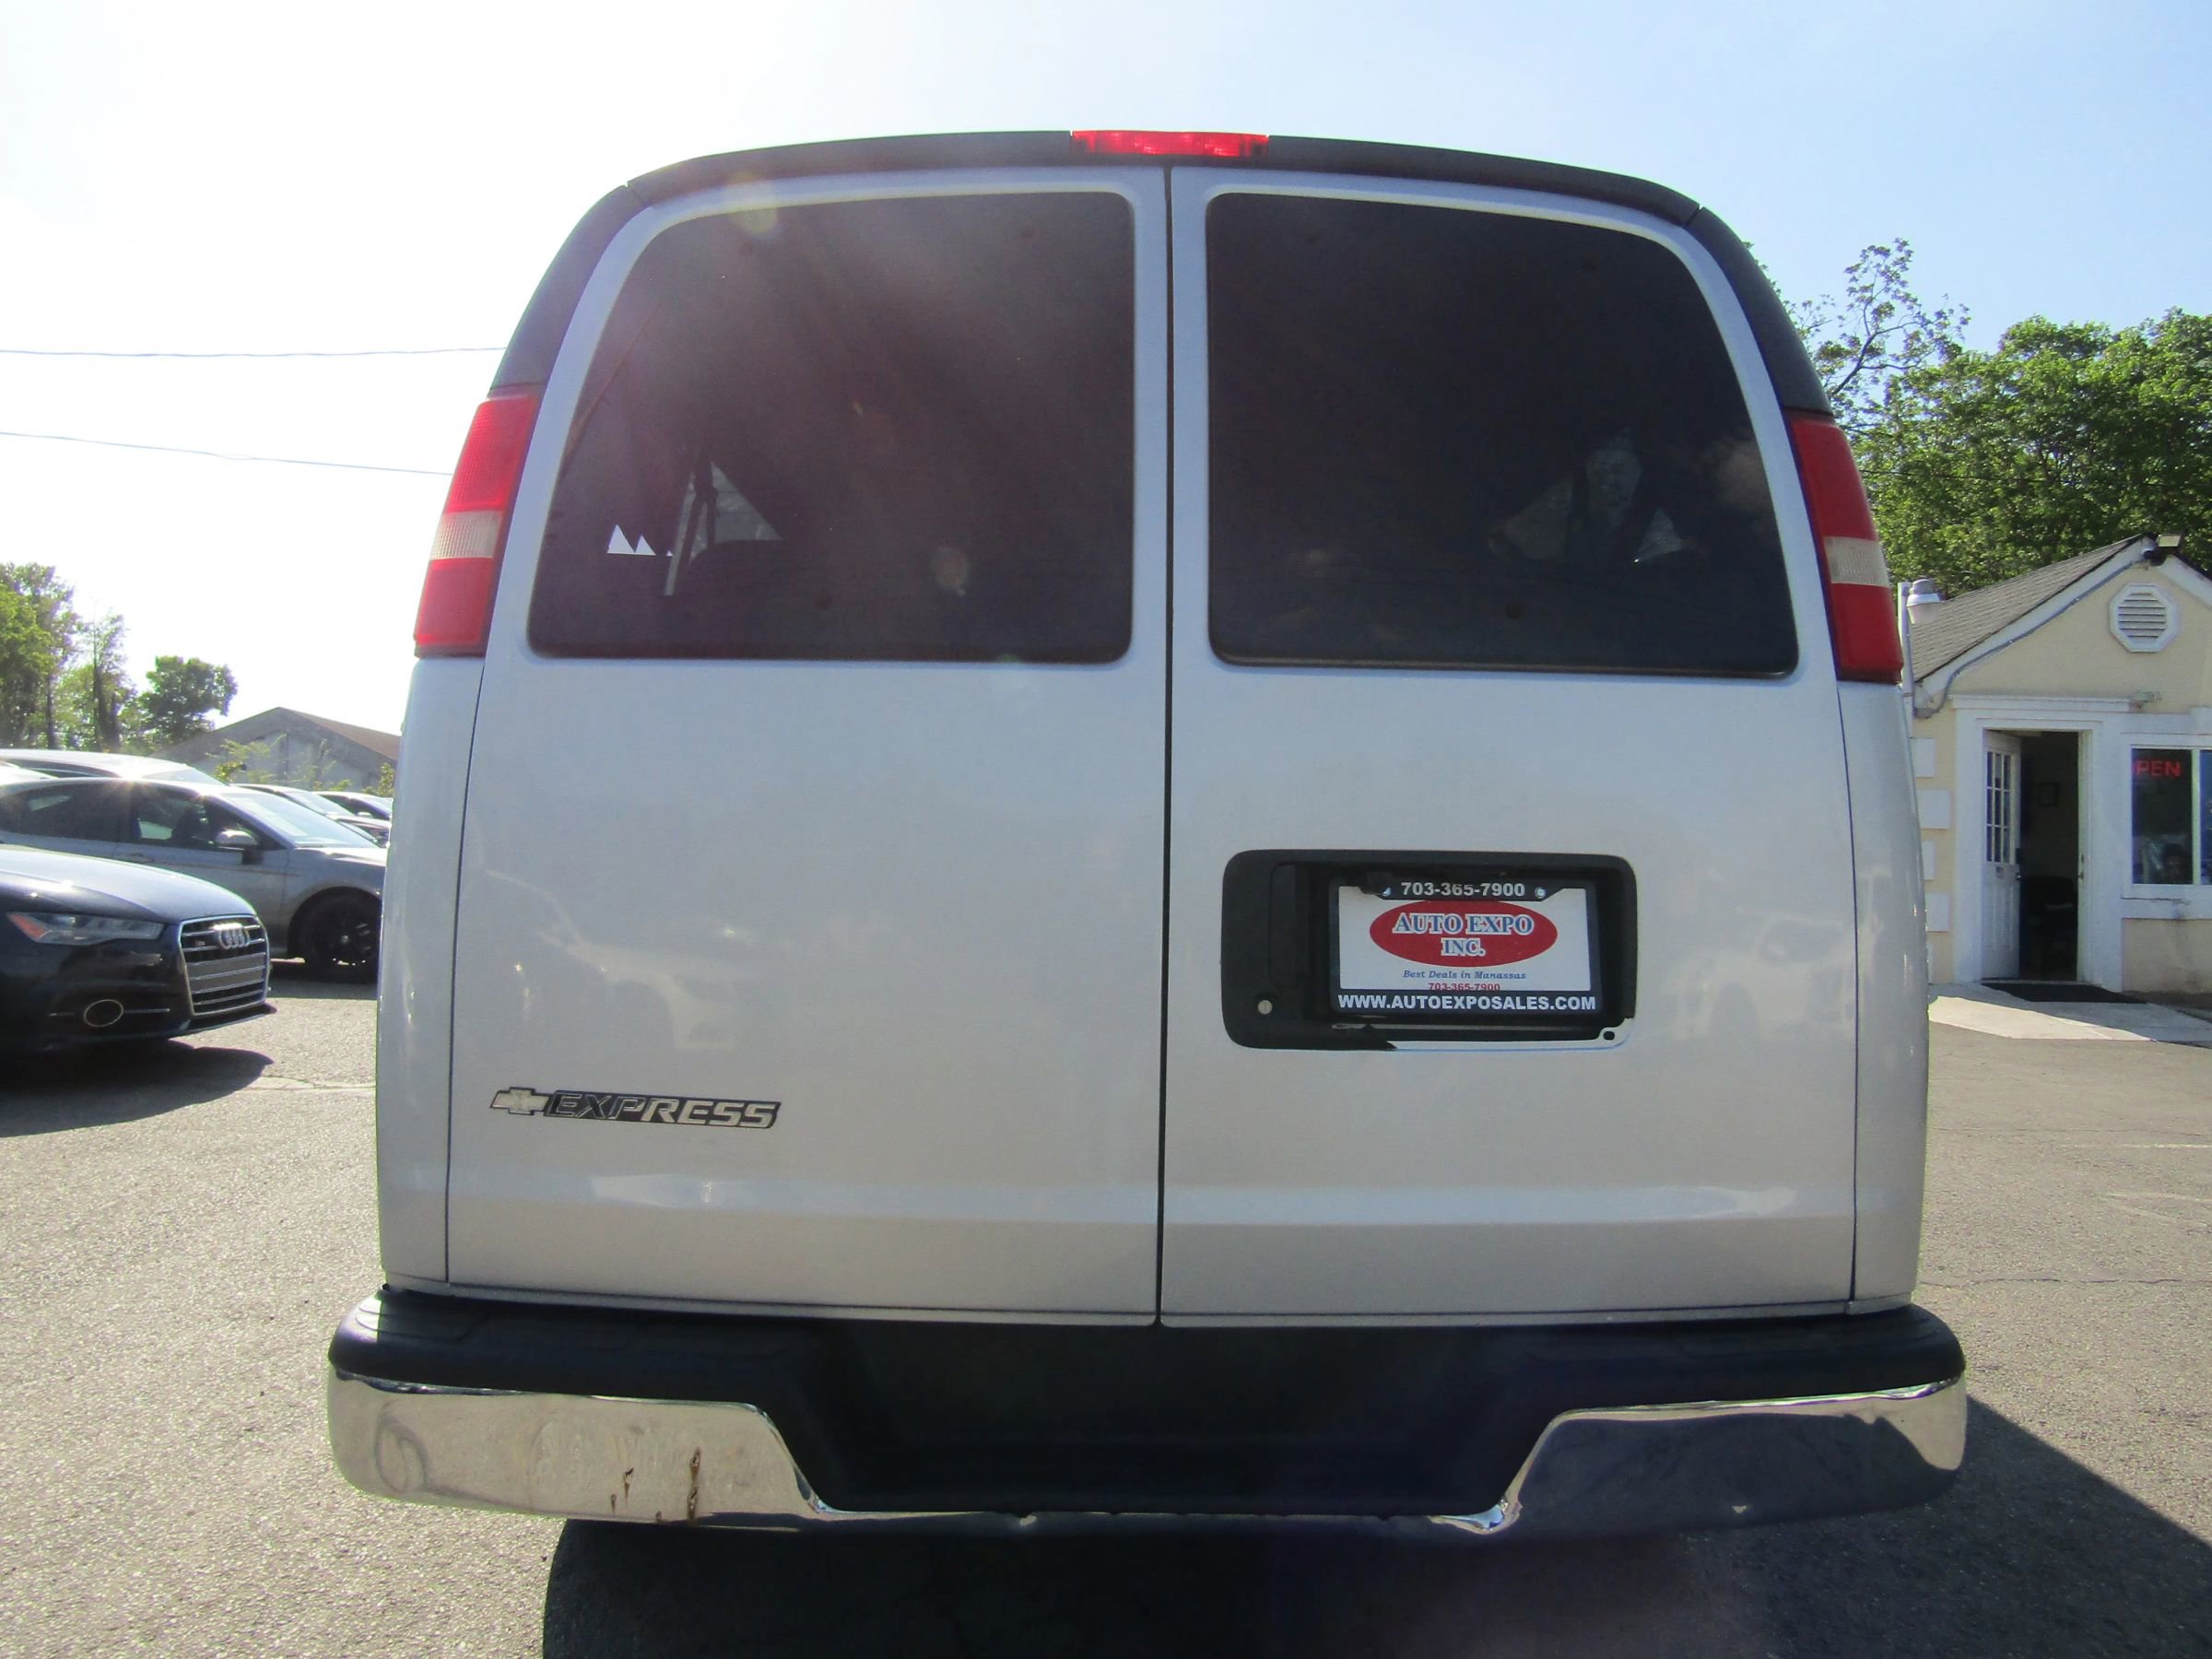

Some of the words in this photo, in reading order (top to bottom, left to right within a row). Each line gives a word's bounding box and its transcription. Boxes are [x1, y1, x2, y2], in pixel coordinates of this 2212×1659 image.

[2132, 759, 2182, 777] PEN
[1401, 882, 1525, 897] 703-365-7900
[1393, 912, 1462, 934] AUTO
[1465, 913, 1535, 935] EXPO
[1441, 937, 1486, 956] INC.
[1403, 970, 1425, 979] Best
[1429, 971, 1457, 979] Deals
[1461, 971, 1471, 979] in
[1475, 971, 1526, 980] Manassas
[1429, 982, 1500, 991] 703-365-7900
[1338, 994, 1595, 1010] WWW.AUTOEXPOSALES.COM
[547, 1091, 779, 1128] EXPRESS
